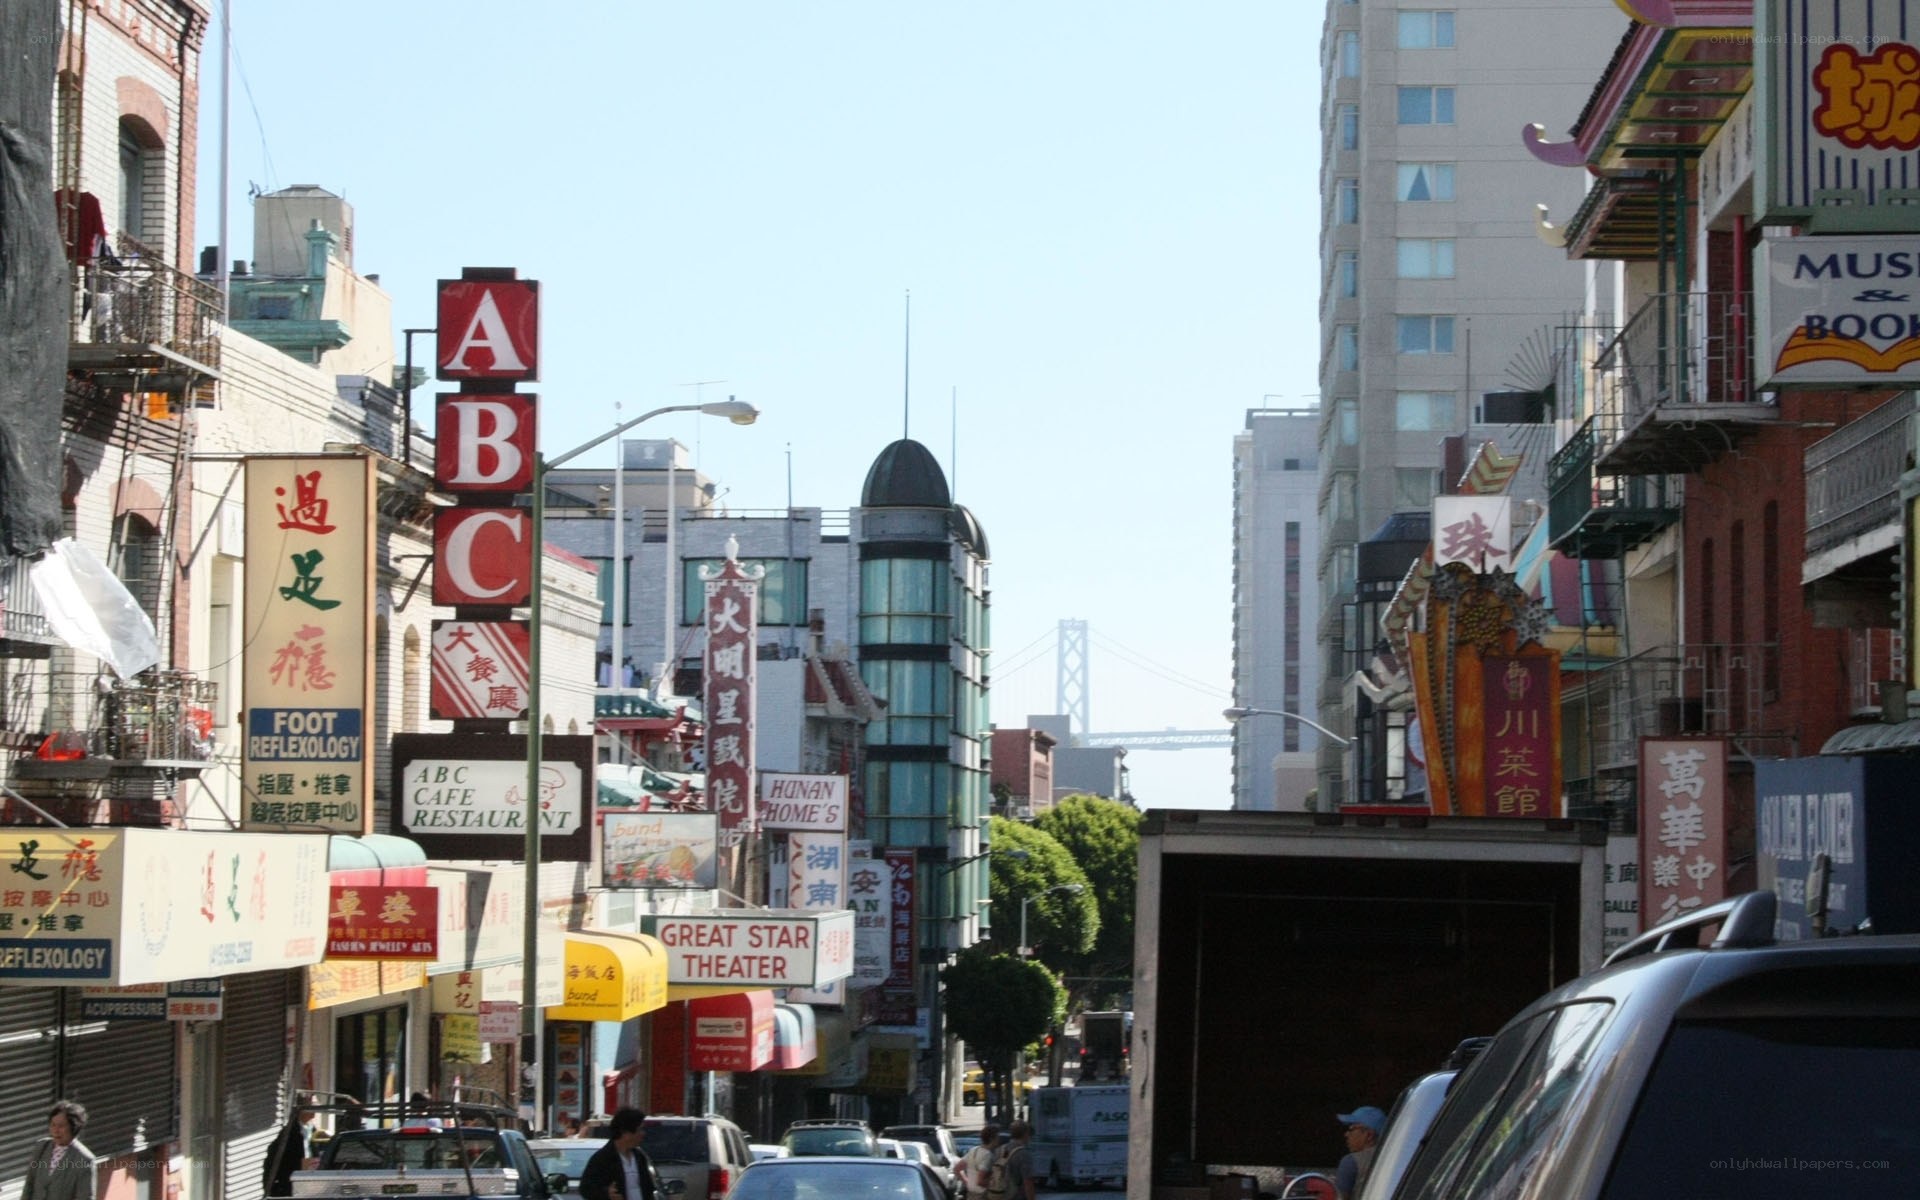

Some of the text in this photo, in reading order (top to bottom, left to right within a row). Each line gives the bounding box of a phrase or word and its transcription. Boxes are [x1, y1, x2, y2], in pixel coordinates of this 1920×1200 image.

[1814, 43, 1920, 149] 城
[1852, 289, 1911, 302] &
[443, 288, 528, 599] A B C
[1440, 511, 1507, 569] 珠
[270, 470, 341, 692] 過足癮
[443, 625, 521, 712] 大餐廳
[273, 711, 338, 734] FOOT
[250, 735, 360, 759] REFLEXOLOGY
[413, 766, 469, 784] ABC
[413, 787, 476, 806] CAFE
[770, 779, 836, 800] HUNAN
[411, 809, 572, 829] RESTAURNT
[764, 803, 840, 824] HOME'S
[805, 844, 840, 907] 湖南
[660, 923, 737, 949] GREAT
[748, 924, 810, 950] STAR
[682, 954, 787, 979] THEATER
[85, 1002, 164, 1016] ACUPRESSURE
